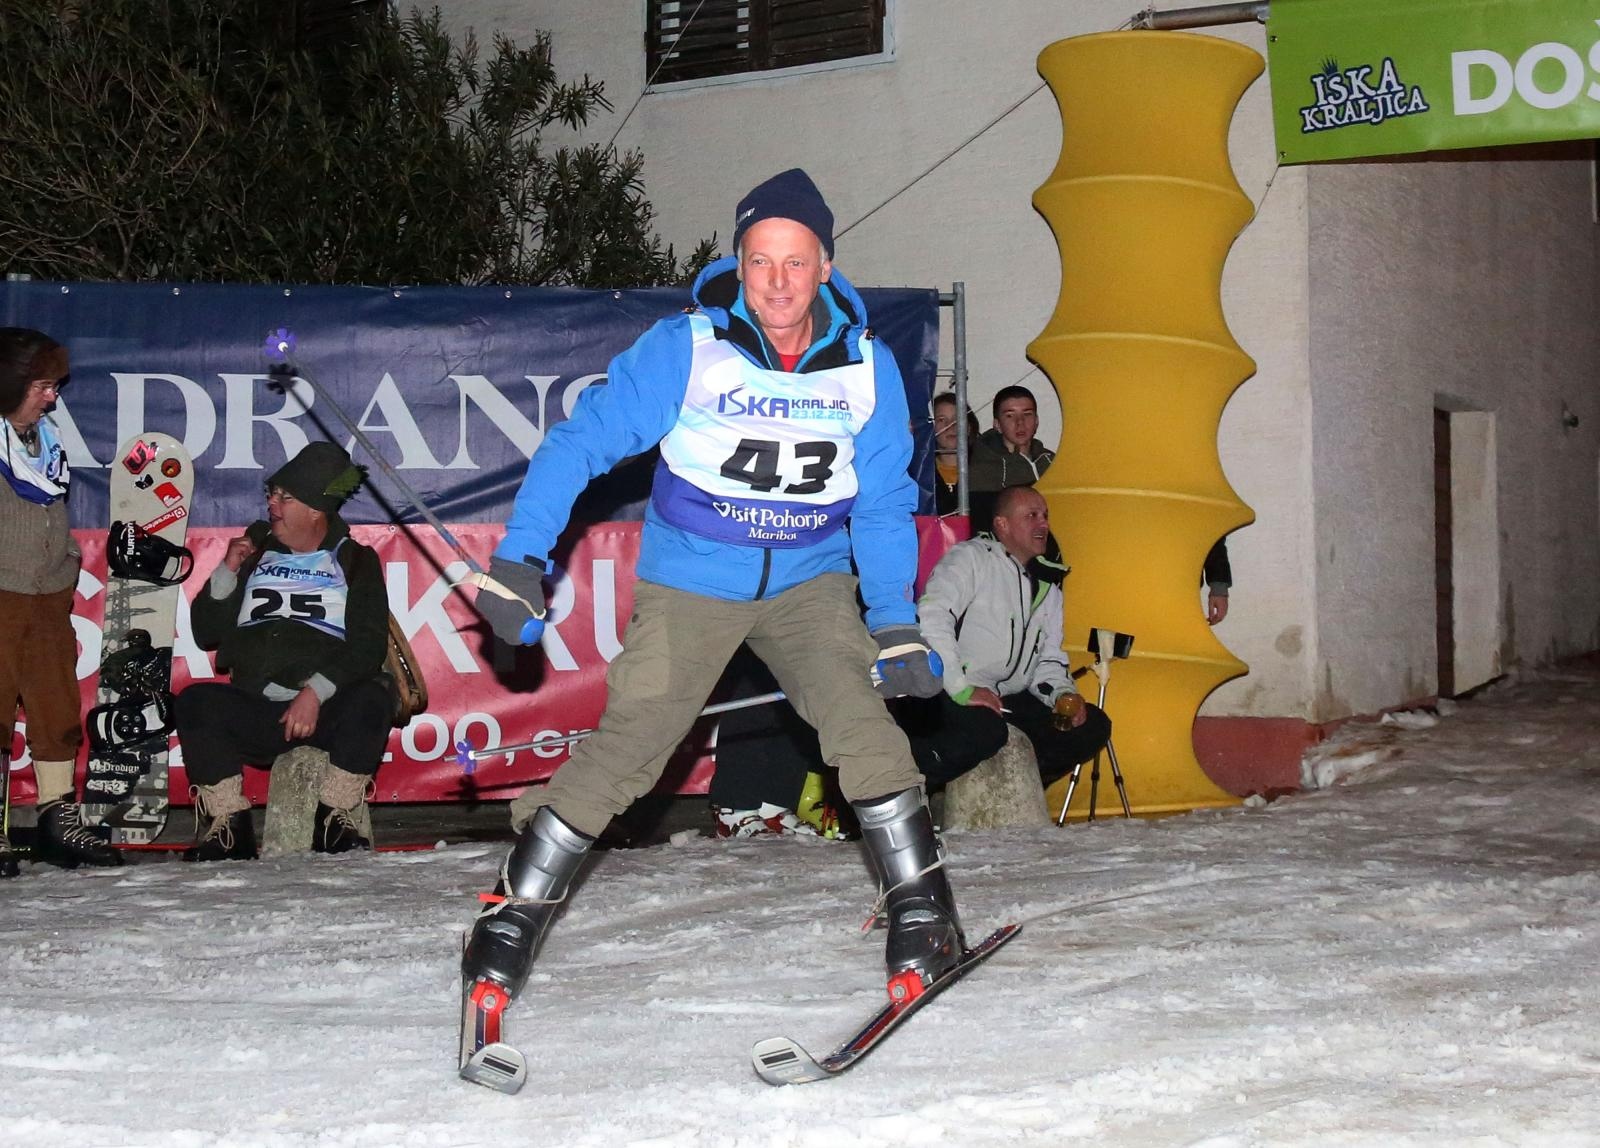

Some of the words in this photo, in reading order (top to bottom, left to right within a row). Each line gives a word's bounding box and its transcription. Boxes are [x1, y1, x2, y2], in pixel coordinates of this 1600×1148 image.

[1312, 59, 1403, 106] ISKA
[1301, 88, 1428, 132] KRALJICA
[717, 382, 789, 419] ISKA
[720, 438, 838, 495] 43
[760, 508, 828, 531] Pohorje
[250, 588, 326, 620] 25
